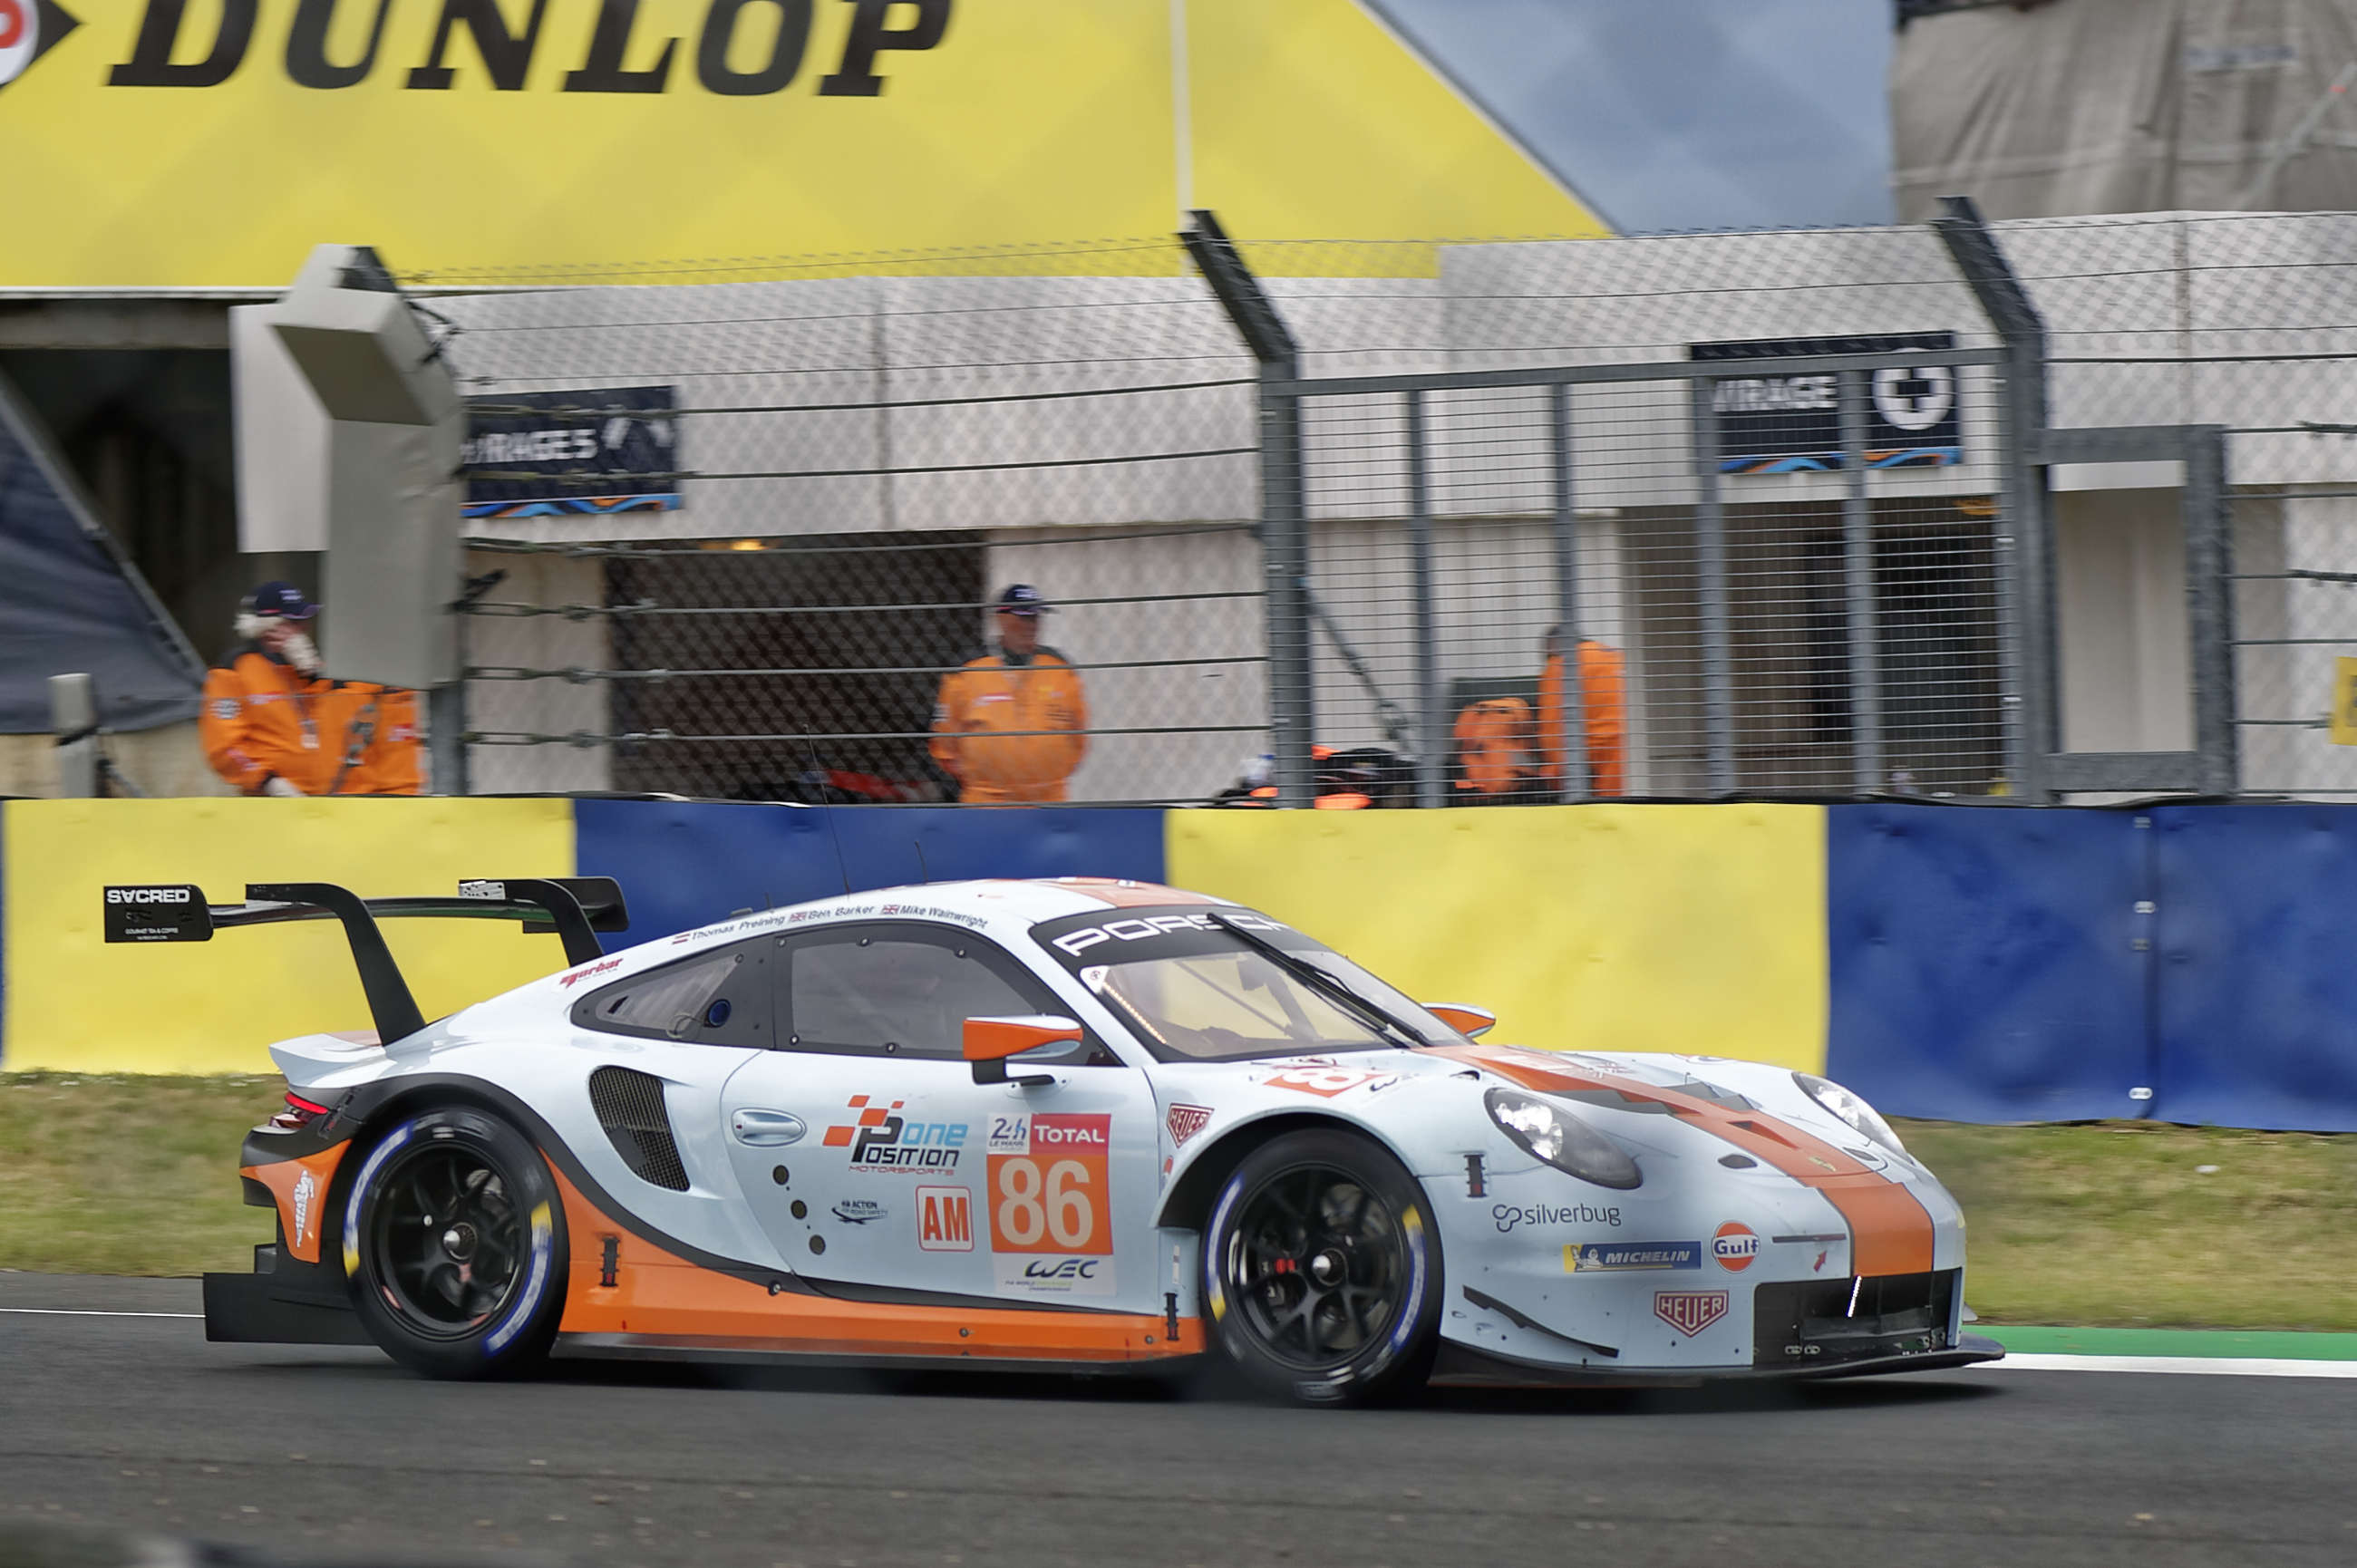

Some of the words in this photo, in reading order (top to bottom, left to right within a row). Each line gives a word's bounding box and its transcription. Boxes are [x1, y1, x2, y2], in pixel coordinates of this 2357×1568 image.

[104, 0, 954, 97] DUNLOP
[835, 905, 875, 917] Barker
[900, 905, 926, 916] Mike
[999, 1157, 1093, 1248] 86
[923, 1196, 969, 1241] AM
[1525, 1204, 1622, 1226] silverbug
[1605, 1250, 1691, 1264] MICHELIN
[1714, 1239, 1759, 1255] Gulf
[1660, 1297, 1722, 1329] HEUER
